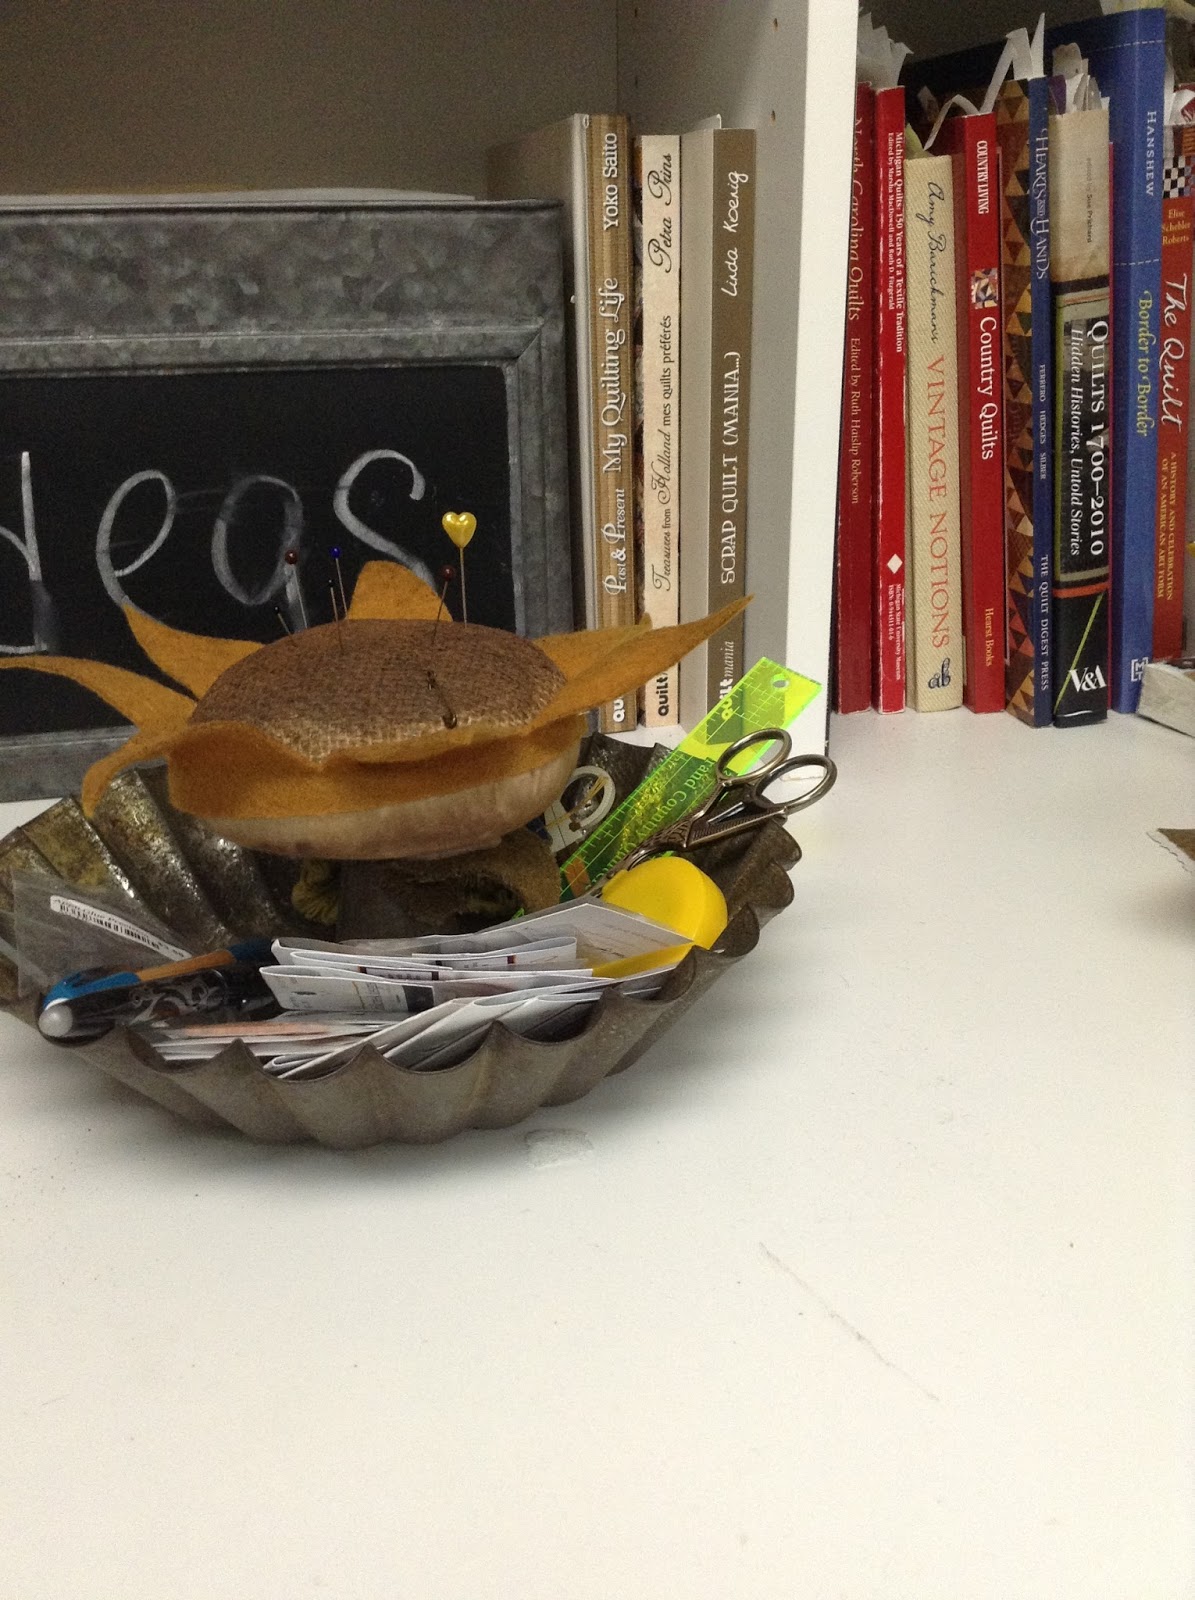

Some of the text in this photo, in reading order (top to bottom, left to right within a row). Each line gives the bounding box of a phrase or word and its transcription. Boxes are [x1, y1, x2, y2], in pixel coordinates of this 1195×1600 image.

[887, 132, 895, 155] Edited
[887, 156, 895, 166] by
[894, 132, 904, 177] Michigan
[1146, 110, 1157, 197] HANSHEW
[602, 133, 620, 230] Yoko Saito
[894, 179, 904, 211] Quilts:
[916, 181, 945, 227] Amy
[976, 140, 990, 215] COUNTRY LIVING
[1030, 129, 1051, 280] HEARTS AND HANDS
[647, 153, 673, 273] Petra Prins
[720, 171, 749, 297] Linda Koenig
[894, 213, 903, 229] 150
[894, 232, 904, 256] Years
[894, 258, 904, 268] of
[887, 276, 895, 310] Fitzgerald
[894, 278, 904, 309] Textile
[894, 311, 904, 353] Tradition
[1158, 273, 1188, 433] The Quilt
[976, 316, 998, 460] Country Quilts
[1085, 320, 1109, 413] QUILTS
[1134, 290, 1157, 437] Border to Border
[598, 277, 627, 595] Past & Present My Quilting Life
[849, 338, 861, 504] Edited by Ruth Haislip Roberson
[1039, 365, 1047, 480] FERRERO HEDGES SILBER
[1069, 329, 1085, 556] Hidden Histories, Untold Stories
[650, 315, 675, 592] Treasures from Holland mes quilts préférés
[722, 454, 738, 513] QUILT
[1168, 462, 1178, 504] HISTORY
[926, 354, 950, 648] VINTAGE NOTIONS
[1158, 458, 1169, 599] OF AN AMERICAN ART FORM
[1167, 508, 1177, 531] AND
[721, 520, 737, 584] SCRAP
[1166, 532, 1177, 600] CELEBRATION
[894, 584, 903, 609] Michigan
[894, 610, 903, 625] State
[1039, 554, 1049, 691] THE QUILT DIGEST PRESS
[984, 608, 995, 667] Hearst Books
[656, 672, 671, 716] quilt
[1069, 665, 1107, 692] V&A
[684, 758, 716, 789] rand
